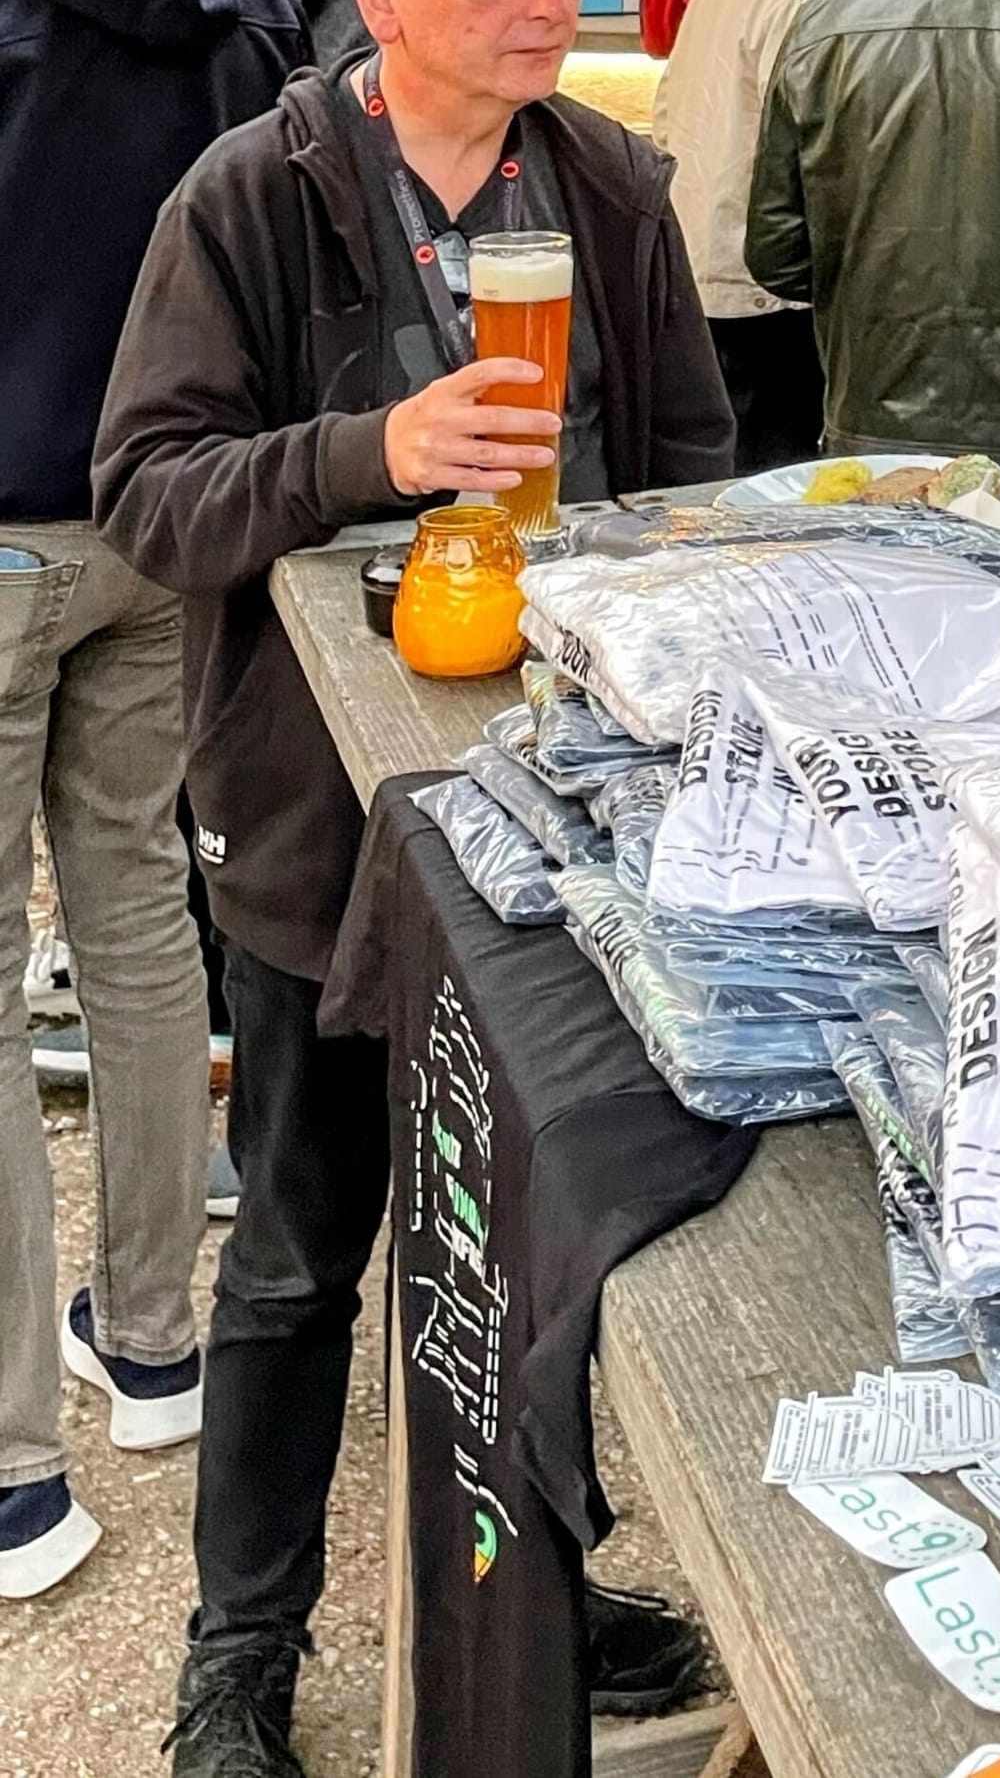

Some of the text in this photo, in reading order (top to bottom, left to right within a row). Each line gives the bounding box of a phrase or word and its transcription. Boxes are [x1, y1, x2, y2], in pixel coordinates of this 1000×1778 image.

[680, 689, 723, 793] DESIGN
[880, 730, 948, 812] STORE
[959, 917, 999, 1090] DESIGN
